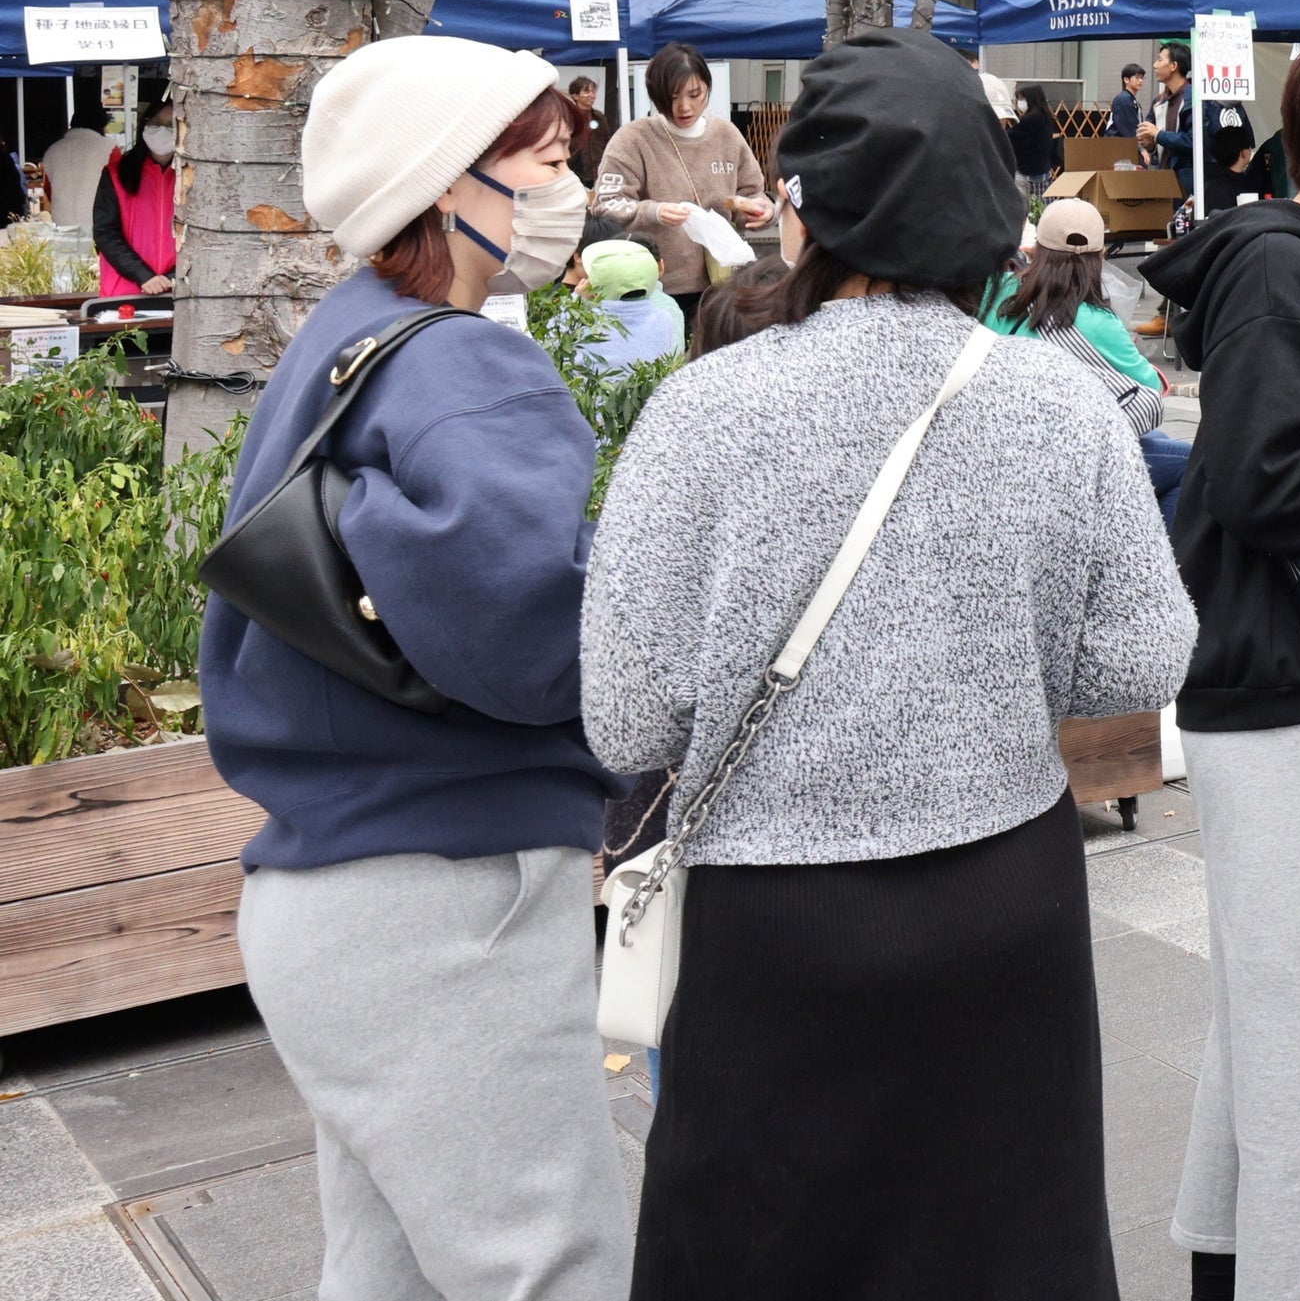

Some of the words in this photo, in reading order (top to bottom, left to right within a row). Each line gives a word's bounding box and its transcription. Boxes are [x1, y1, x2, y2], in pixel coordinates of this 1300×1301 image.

[1050, 12, 1110, 30] UNIVERSITY
[1202, 77, 1249, 96] 100円
[711, 161, 734, 174] GAP
